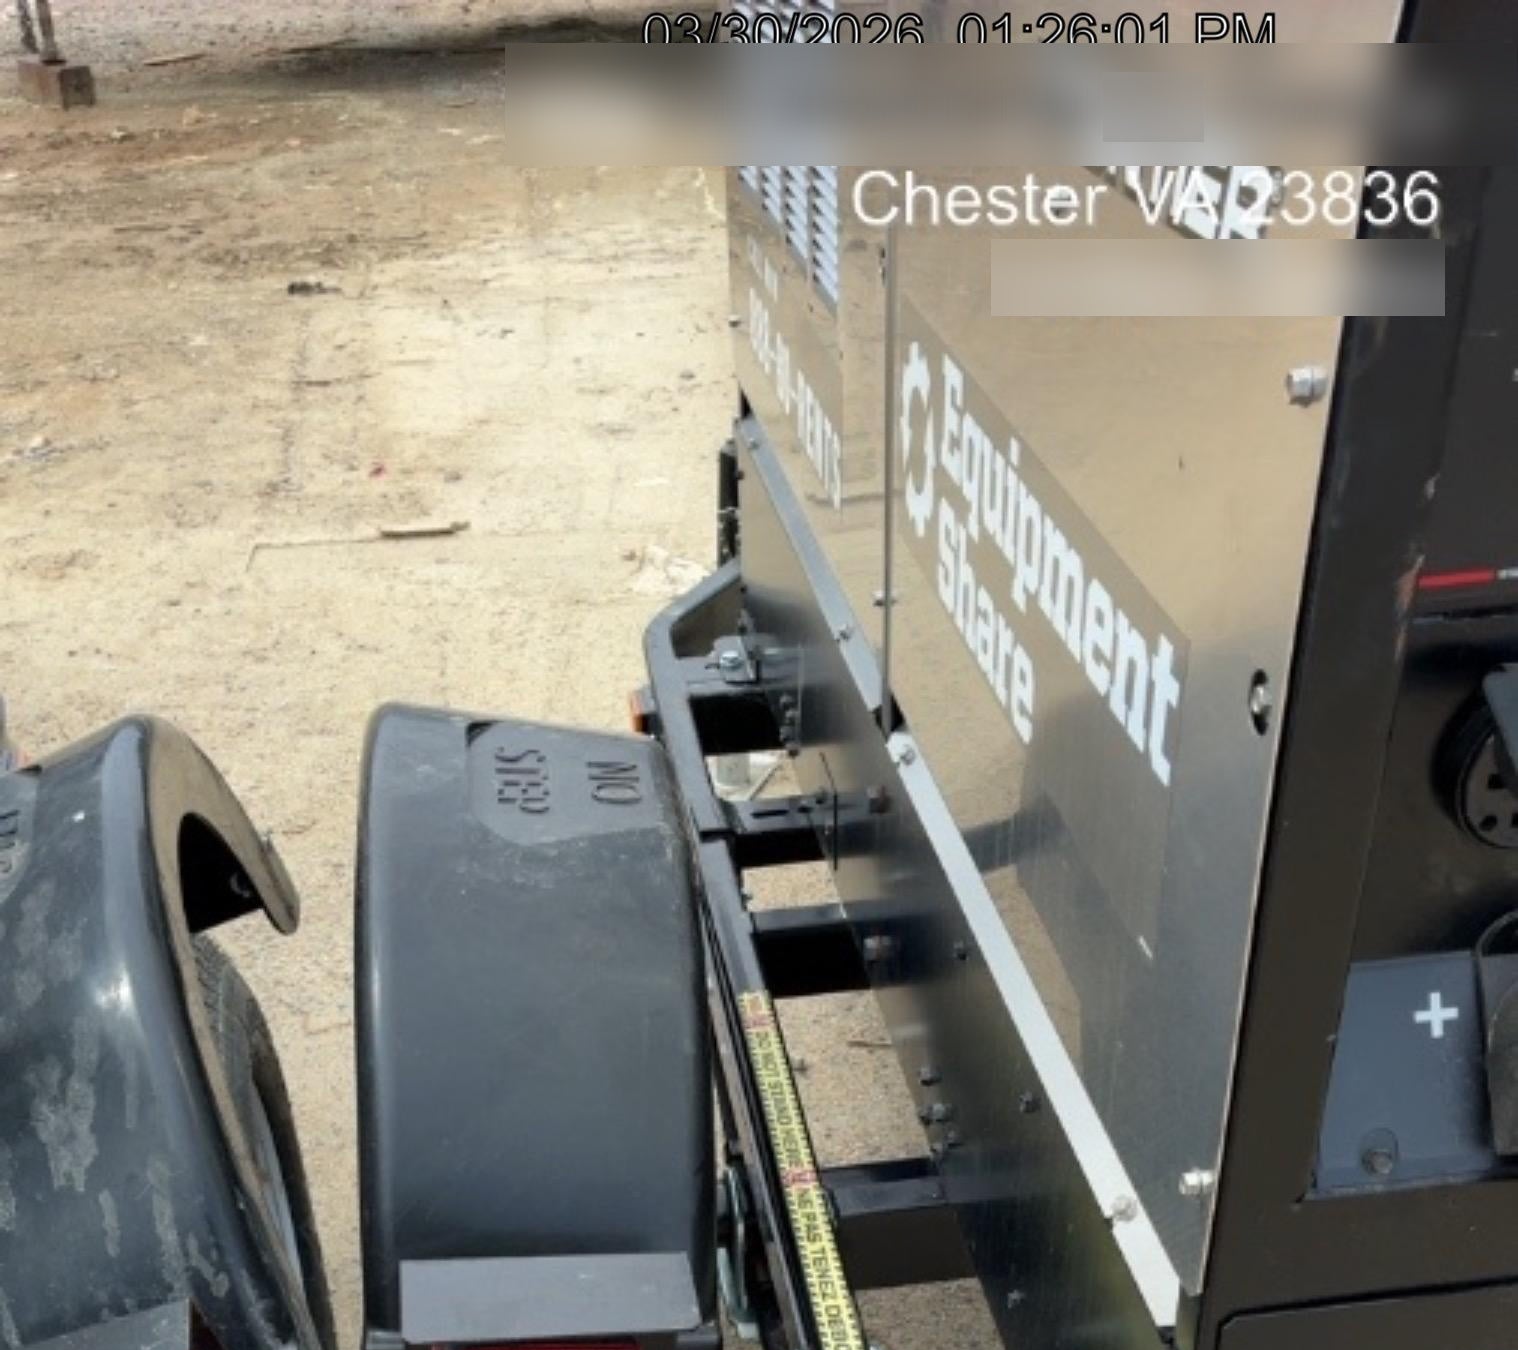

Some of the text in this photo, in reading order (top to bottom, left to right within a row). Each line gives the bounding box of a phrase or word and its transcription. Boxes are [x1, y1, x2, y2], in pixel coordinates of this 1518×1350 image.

[936, 496, 1034, 745] Share
[941, 352, 1181, 787] Equipment
[495, 747, 550, 814] STEP
[585, 761, 643, 805] NO
